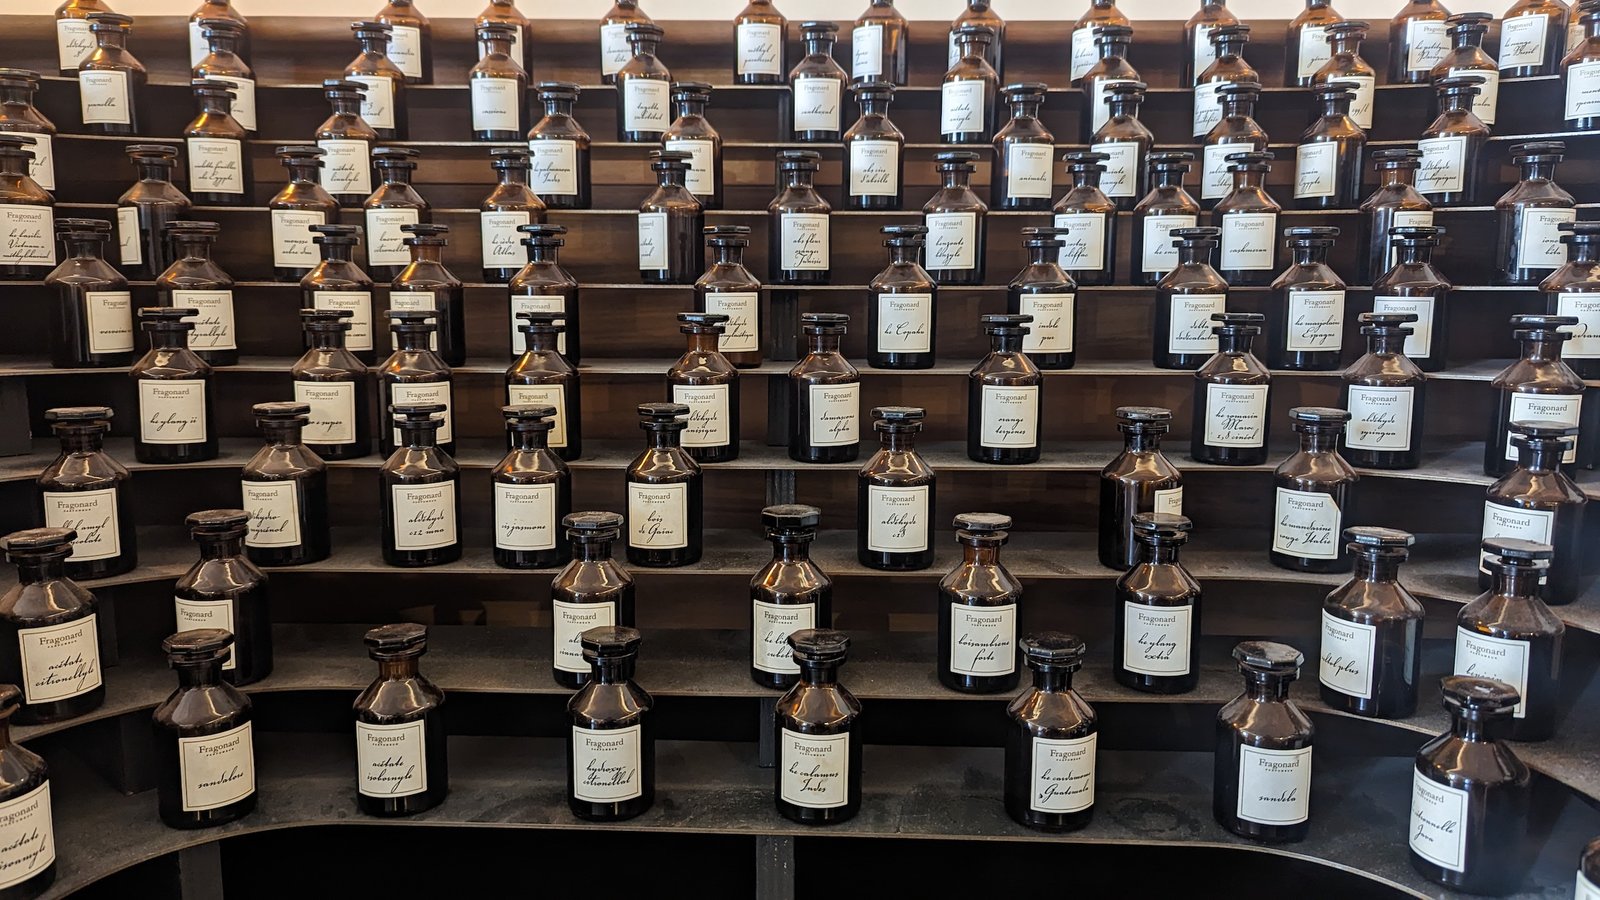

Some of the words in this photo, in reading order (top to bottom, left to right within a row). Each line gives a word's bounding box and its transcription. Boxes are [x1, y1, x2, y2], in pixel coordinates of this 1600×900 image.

[86, 76, 112, 85] Fragonard
[804, 84, 829, 92] Fragonard
[1022, 150, 1046, 158] Fragonard
[7, 212, 41, 220] Fragonard
[280, 216, 310, 224] Fragonard
[1540, 216, 1569, 224] Fragonard
[793, 221, 820, 229] Fragonard
[890, 301, 919, 309] Fragonard
[1384, 304, 1417, 312] Fragonard
[153, 388, 189, 396] Fragonard
[407, 391, 439, 399] Fragonard
[823, 391, 852, 400] Fragonard
[1221, 392, 1254, 400] Fragonard
[684, 393, 715, 401] Fragonard
[1361, 394, 1397, 402] Fragonard
[1528, 402, 1568, 412] Fragonard
[248, 490, 278, 498] Fragonard
[407, 491, 442, 501] Fragonard
[505, 492, 539, 500] Fragonard
[638, 492, 671, 500] Fragonard
[881, 495, 915, 503] Fragonard
[1288, 498, 1323, 508] Fragonard
[57, 500, 98, 509] Fragonard
[1492, 513, 1530, 527] Fragonard
[180, 608, 213, 618] Fragonard
[563, 612, 597, 620] Fragonard
[764, 611, 798, 621] Fragonard
[966, 615, 1002, 624] Fragonard
[1138, 613, 1176, 623] Fragonard
[1325, 622, 1354, 639] Fragonard
[39, 629, 83, 646] Fragonard
[1465, 640, 1506, 657] Fragonard
[368, 734, 405, 743] Fragonard
[586, 738, 624, 748] Fragonard
[199, 737, 240, 754] Fragonard
[794, 742, 832, 753] Fragonard
[1050, 748, 1086, 759] Fragonard
[1259, 759, 1300, 768] Fragonard
[0, 801, 39, 823] ragonard
